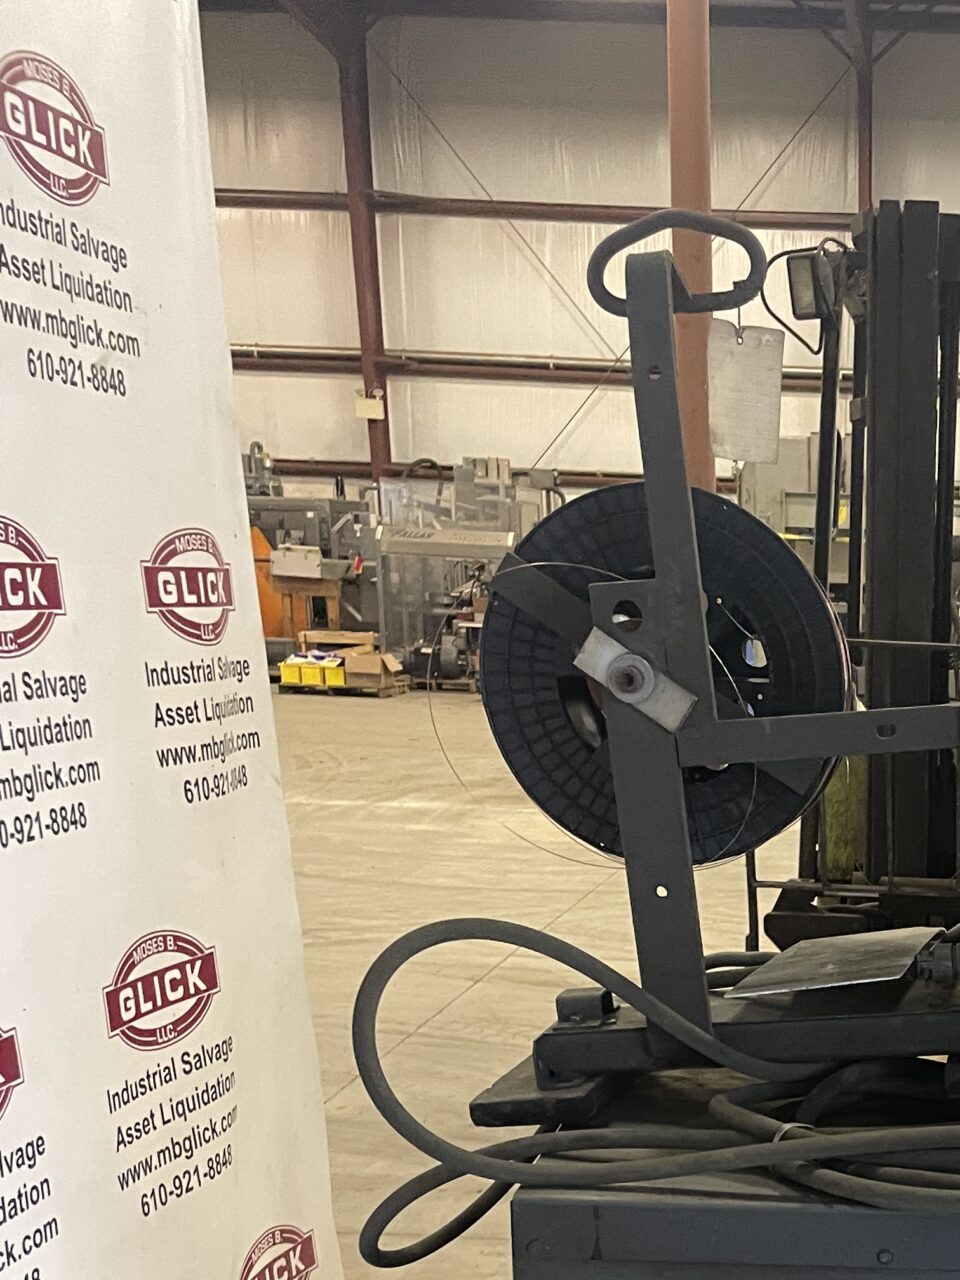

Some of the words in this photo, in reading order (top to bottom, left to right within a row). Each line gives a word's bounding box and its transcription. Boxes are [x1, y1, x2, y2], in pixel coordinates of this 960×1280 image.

[4, 91, 95, 169] GLICK
[71, 222, 128, 273] Salvage
[0, 243, 47, 287] Asset
[50, 259, 133, 313] Liquidation
[0, 300, 141, 357] www.mbglick.com
[27, 347, 127, 397] 610-921-8848
[175, 535, 207, 553] MOSES
[157, 571, 227, 604] GLICK
[22, 670, 87, 702] Salvage
[145, 656, 215, 687] Industrial
[217, 656, 250, 683] Salvage
[0, 714, 93, 755] Liquidation
[154, 700, 201, 728] Asset
[133, 937, 165, 964] MOSES
[118, 960, 207, 1022] GLICK
[156, 1024, 178, 1043] LLC.
[107, 1057, 177, 1114] Industrial
[181, 1036, 233, 1075] Salvage
[116, 1109, 157, 1152] Asset
[160, 1071, 236, 1126] Liquidation
[117, 1104, 238, 1191] www.mbglick.com
[141, 1144, 232, 1217] 610-921-8848
